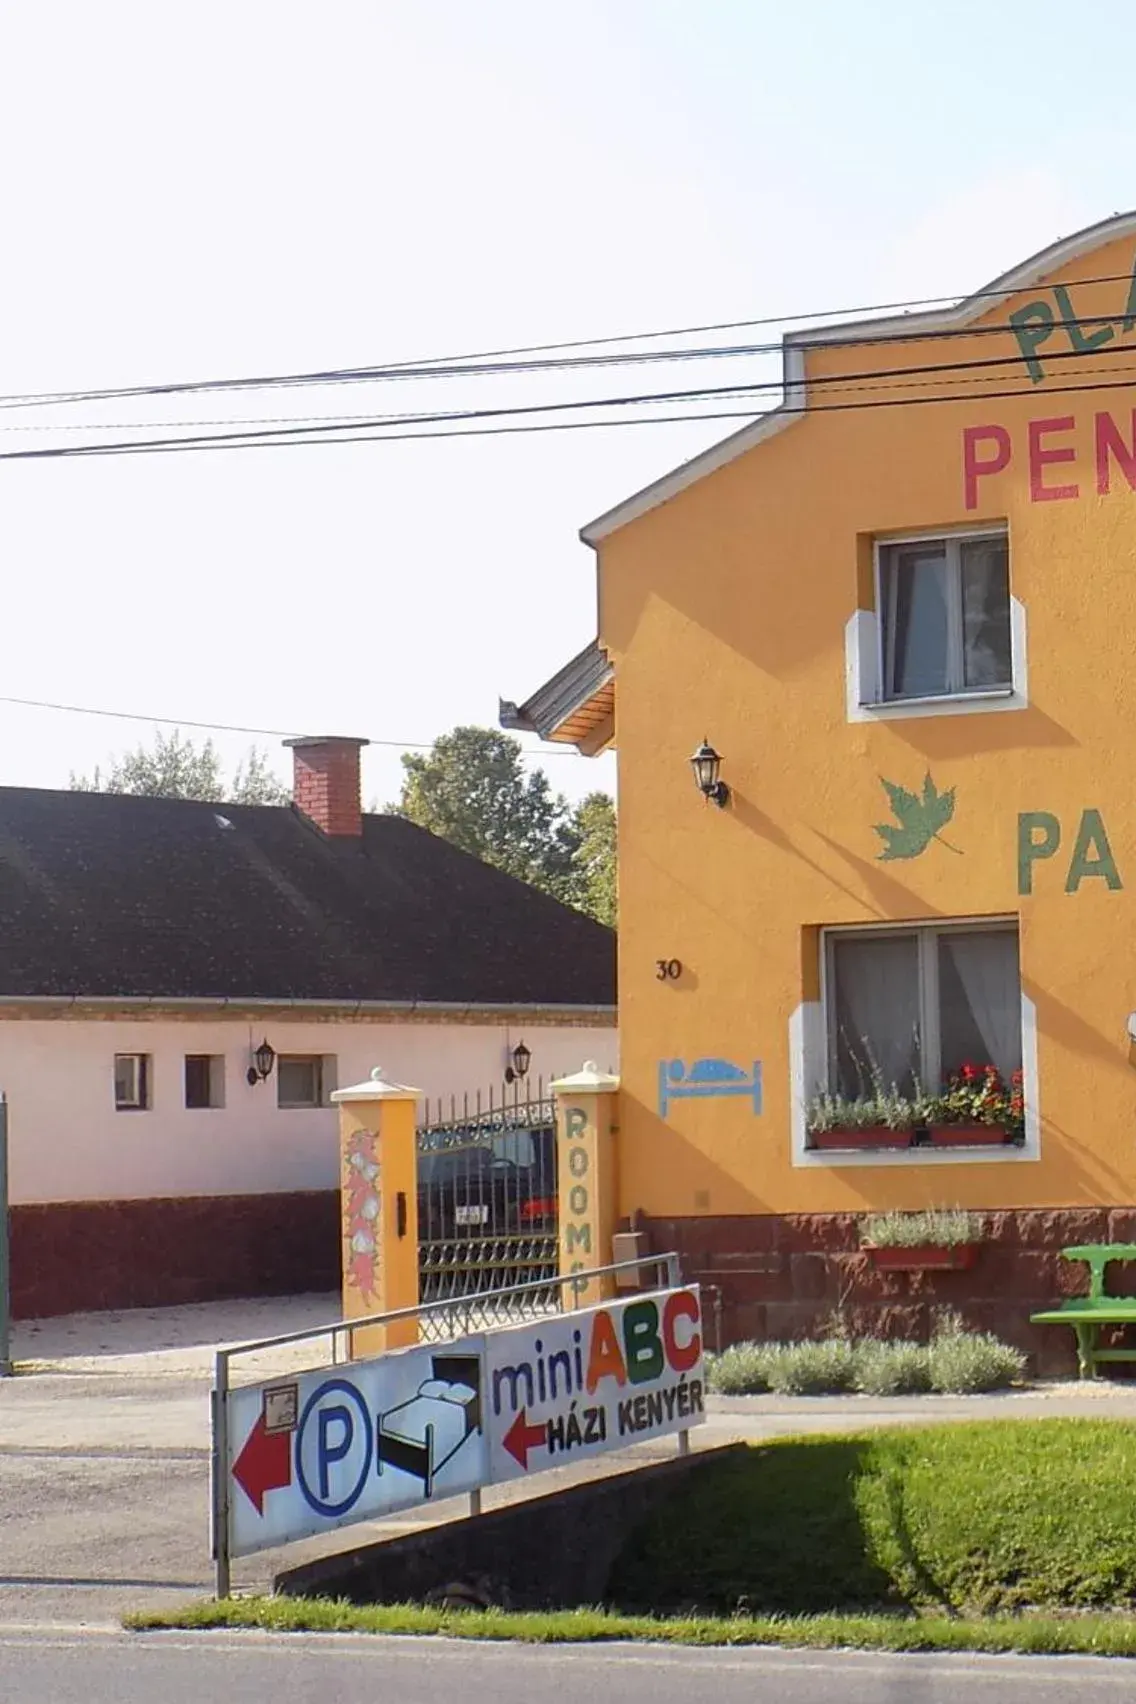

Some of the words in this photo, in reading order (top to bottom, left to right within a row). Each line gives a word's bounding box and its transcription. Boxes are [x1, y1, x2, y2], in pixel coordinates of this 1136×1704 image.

[656, 959, 682, 981] 30
[565, 1107, 592, 1294] ROOMS
[318, 1405, 353, 1499] P
[548, 1401, 606, 1454] HÁZI
[617, 1373, 704, 1436] KENYÉR
